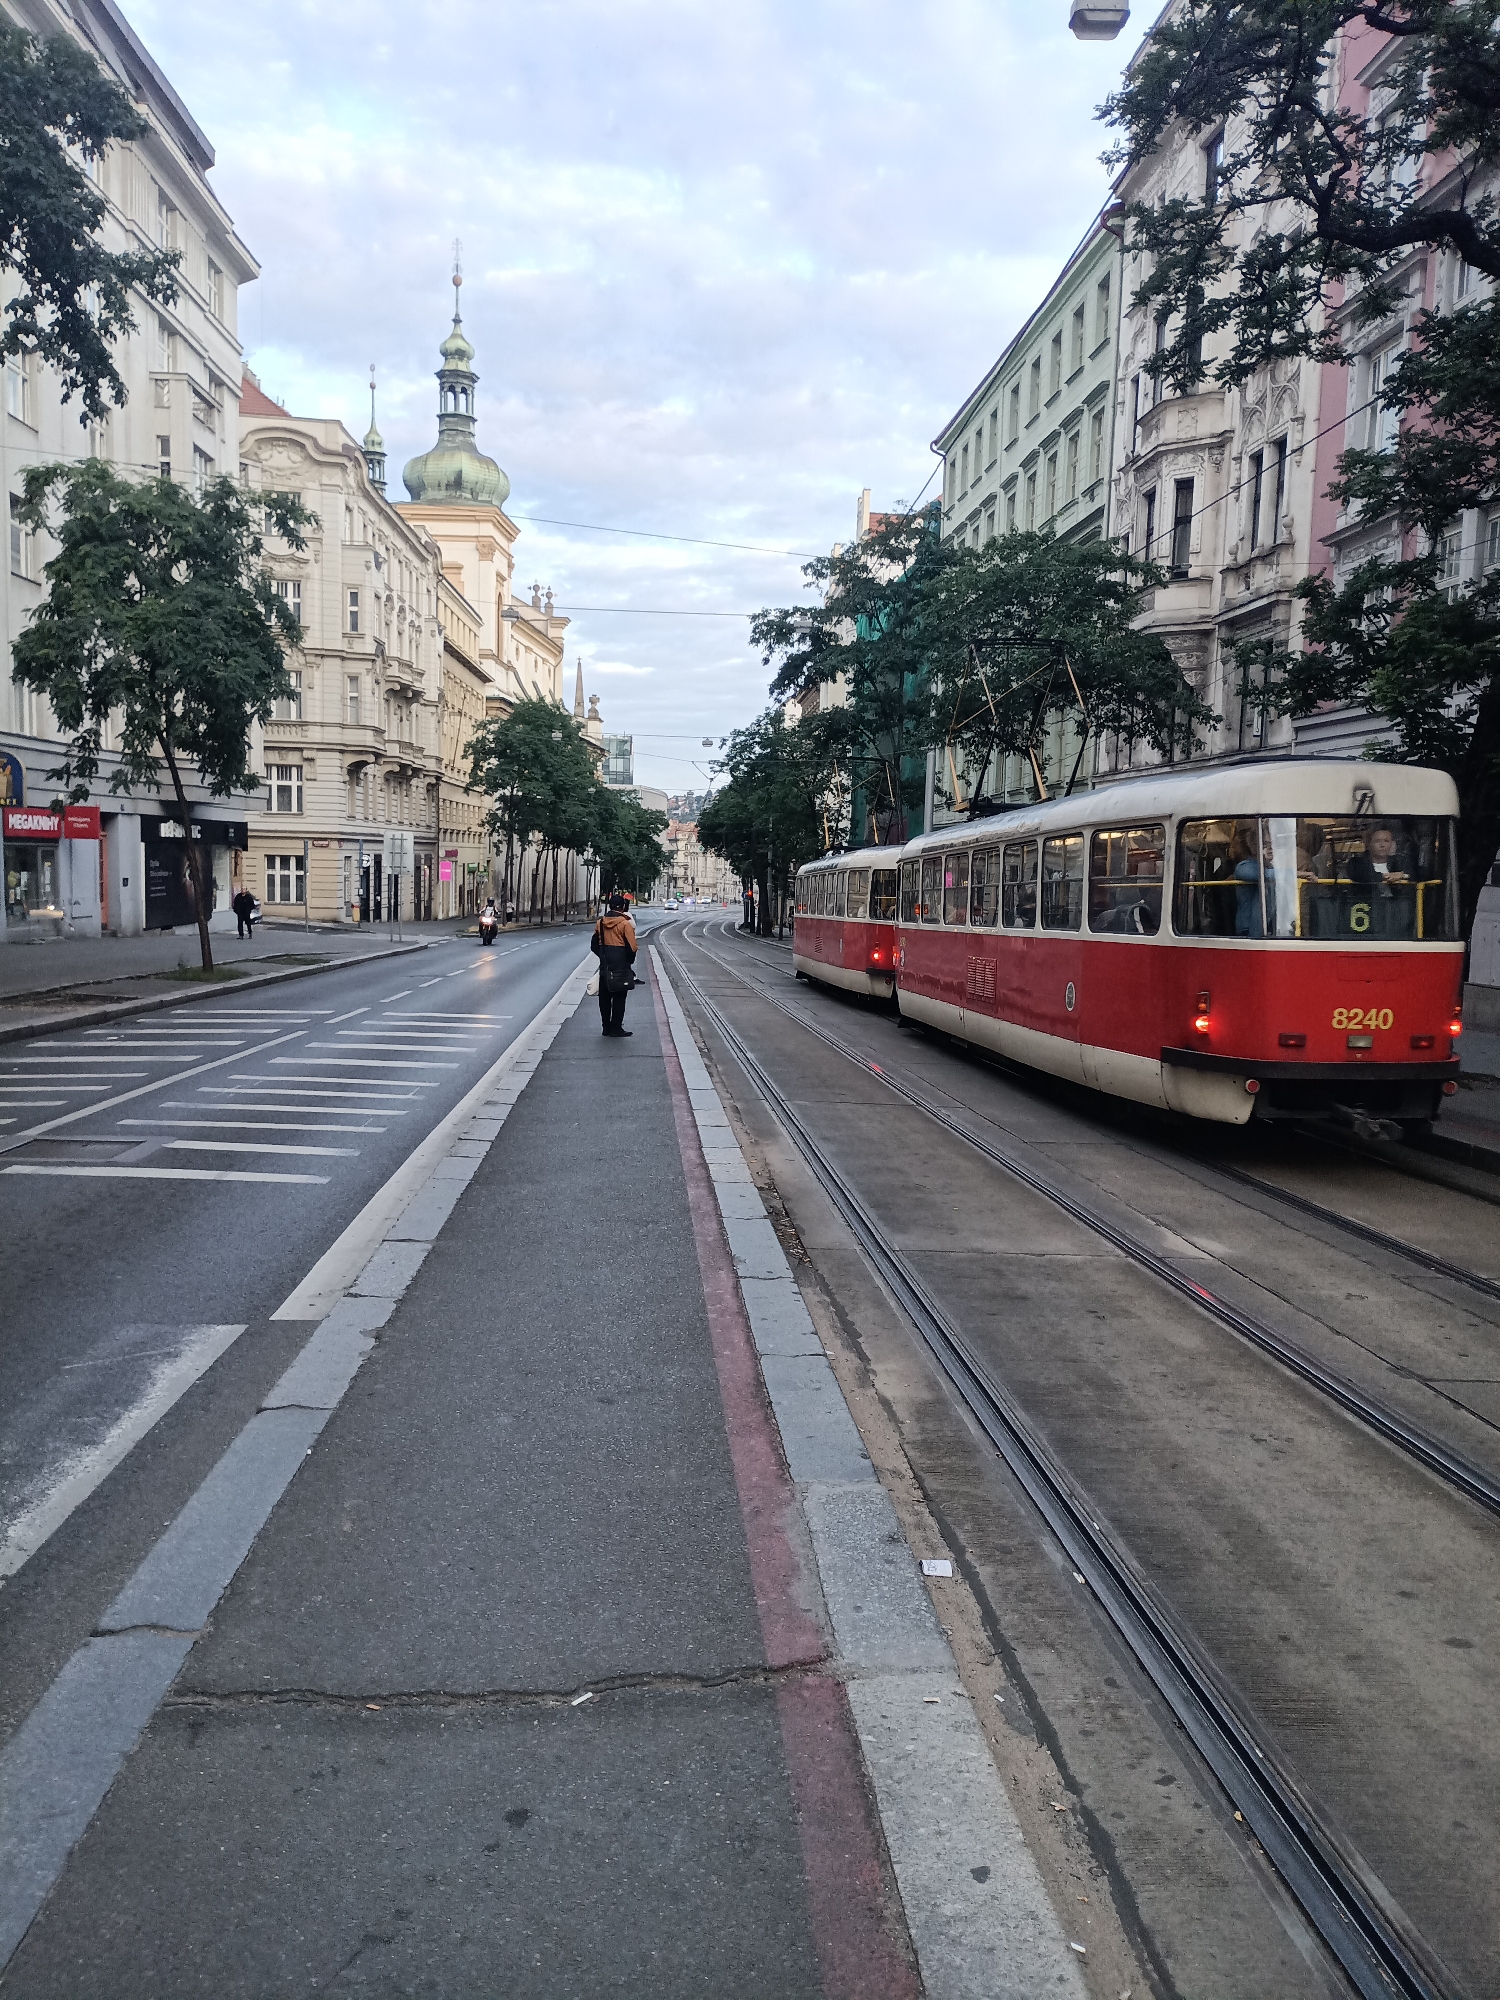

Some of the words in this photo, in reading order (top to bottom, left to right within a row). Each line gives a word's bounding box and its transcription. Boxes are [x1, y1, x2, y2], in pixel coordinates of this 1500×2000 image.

[8, 814, 59, 831] MEGAKNIHY
[1350, 903, 1371, 932] 6
[1331, 1007, 1394, 1030] 8240
